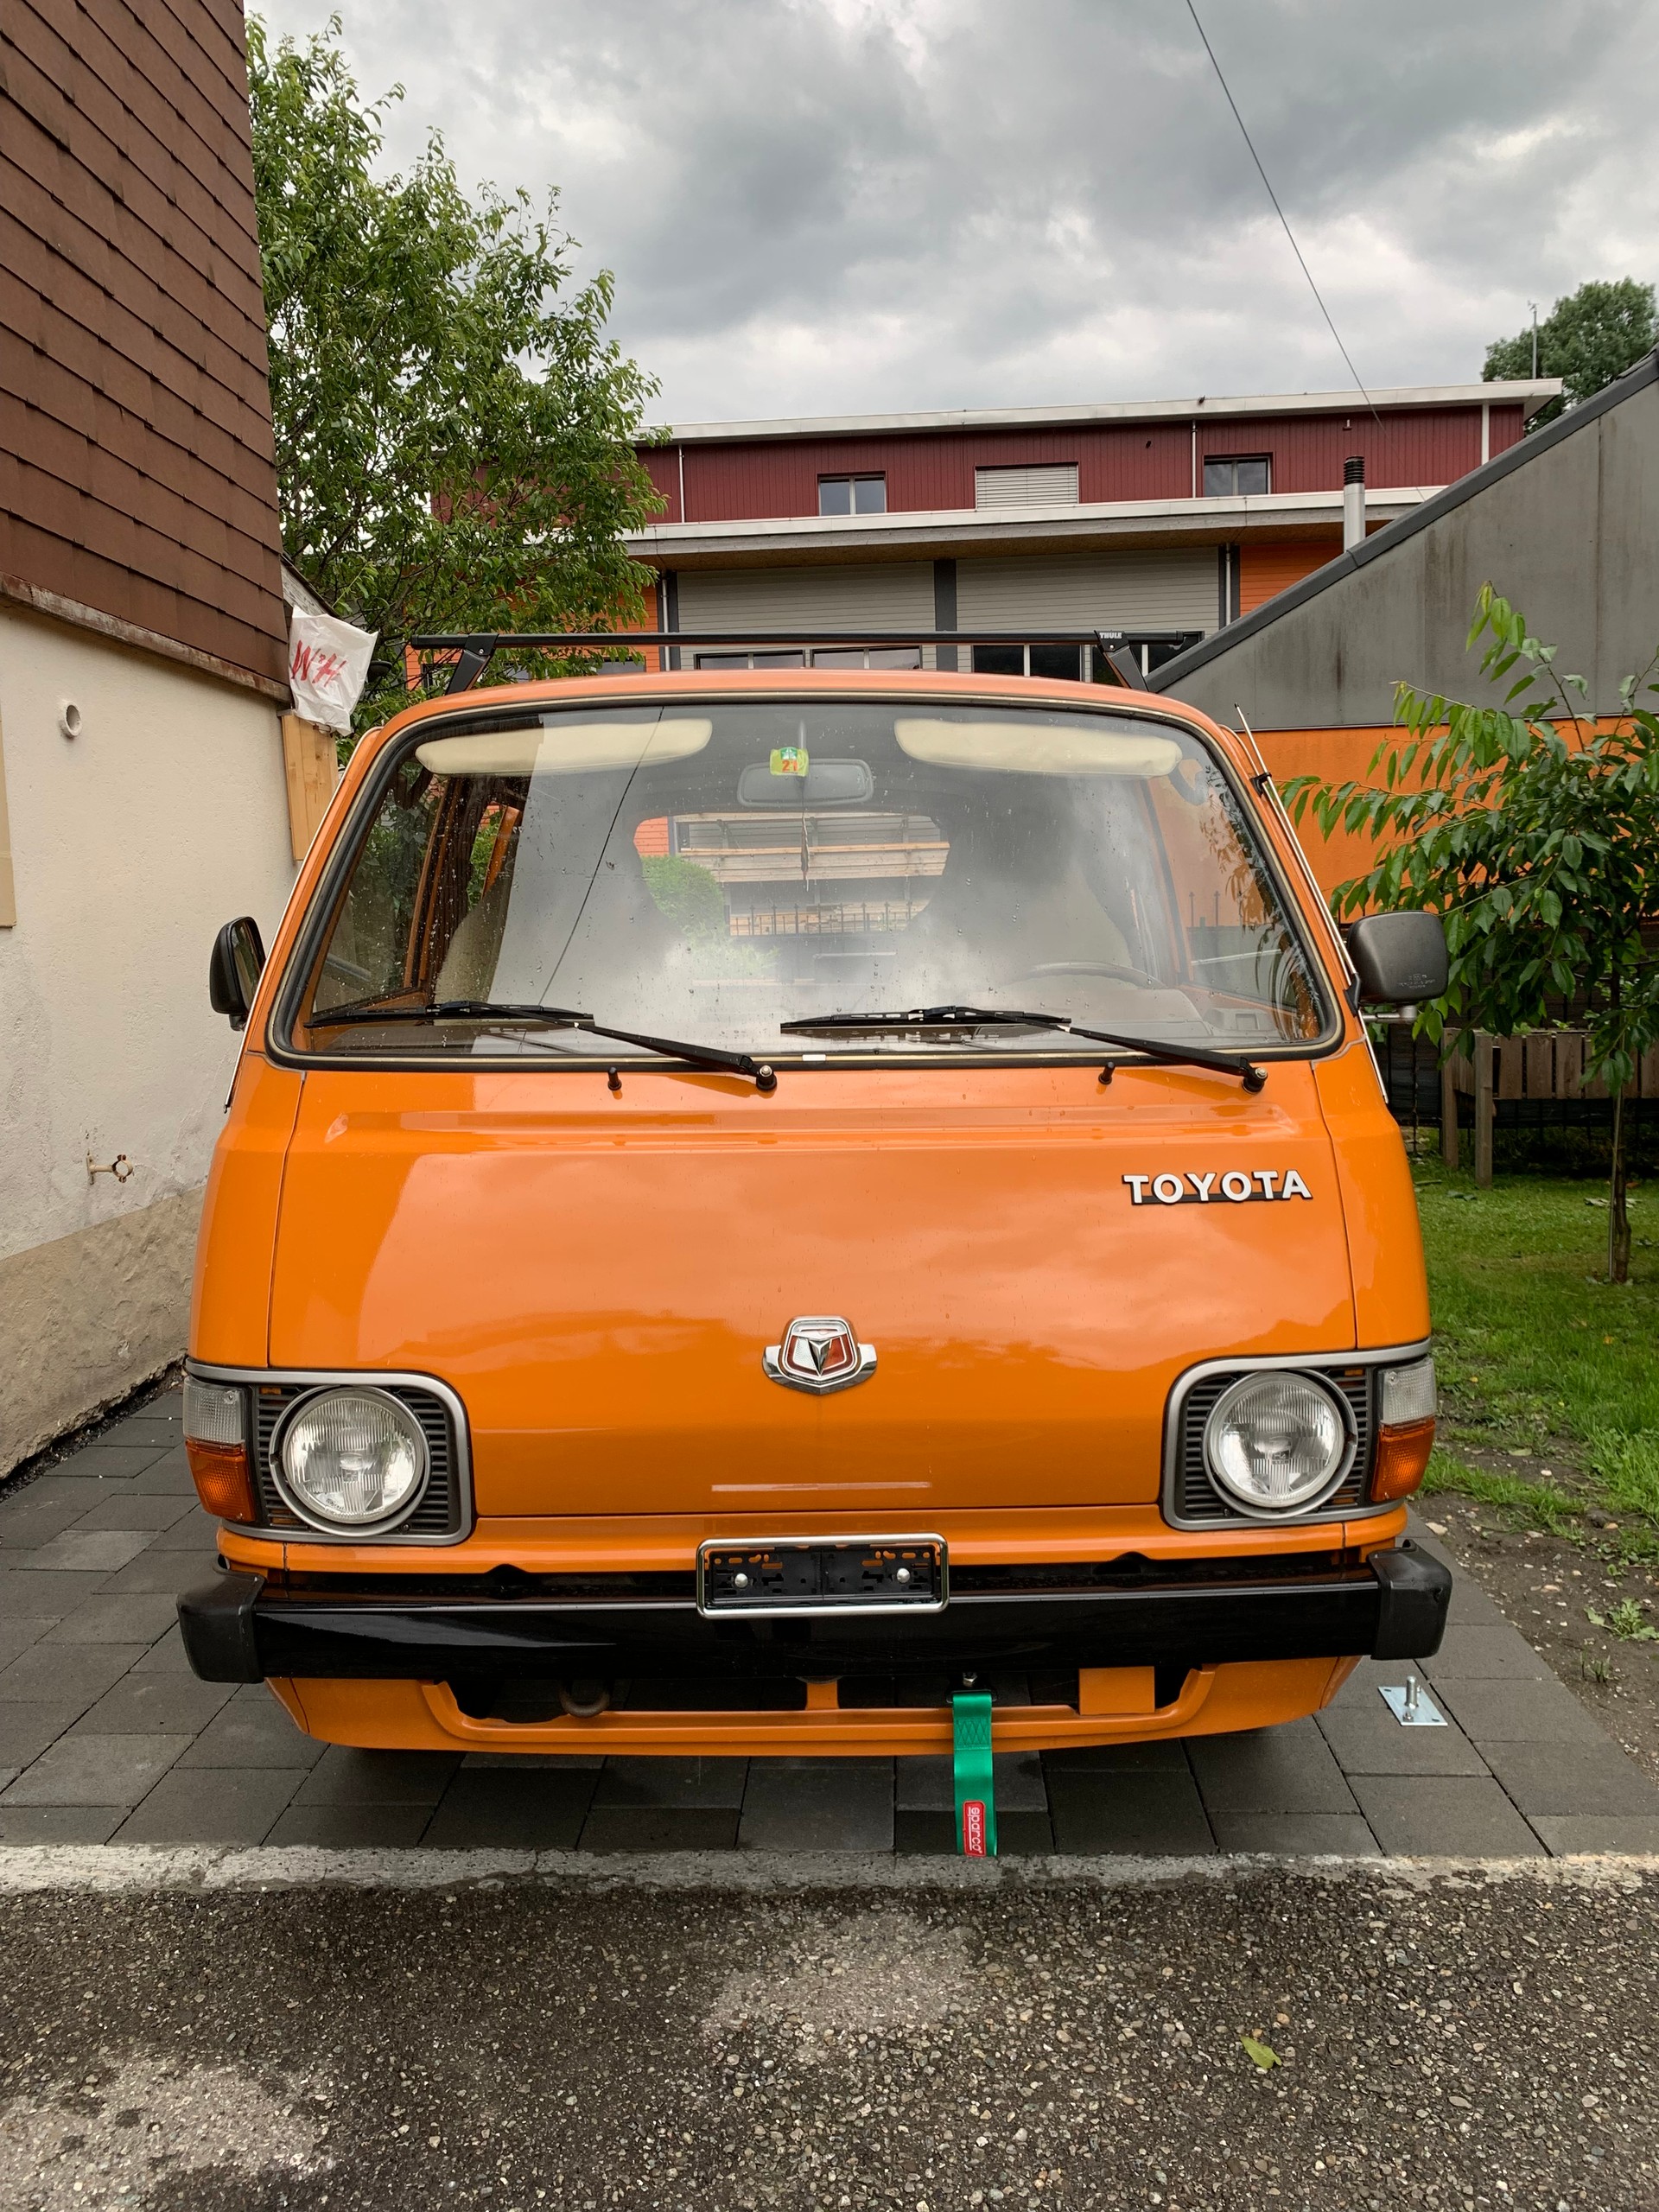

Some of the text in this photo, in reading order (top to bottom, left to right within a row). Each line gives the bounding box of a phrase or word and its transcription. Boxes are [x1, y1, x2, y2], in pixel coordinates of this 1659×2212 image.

[782, 760, 798, 772] 21
[1122, 1170, 1313, 1205] TOYOTA
[968, 1807, 982, 1853] sparco
